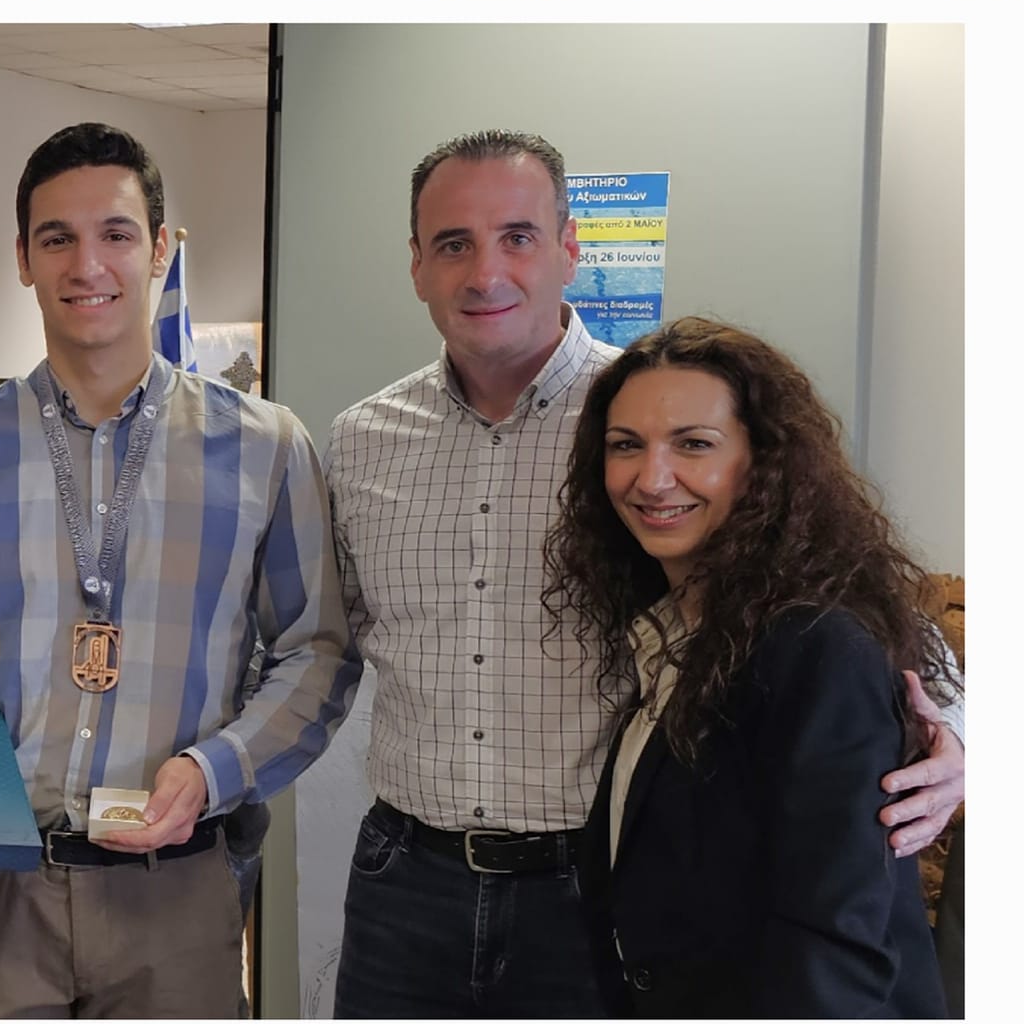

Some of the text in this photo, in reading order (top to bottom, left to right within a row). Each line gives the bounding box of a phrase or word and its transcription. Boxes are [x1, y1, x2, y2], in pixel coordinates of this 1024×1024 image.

[567, 176, 628, 188] ΜΒΗΤΗΡΙΟ
[578, 253, 597, 264] ρξη
[600, 252, 614, 262] 26
